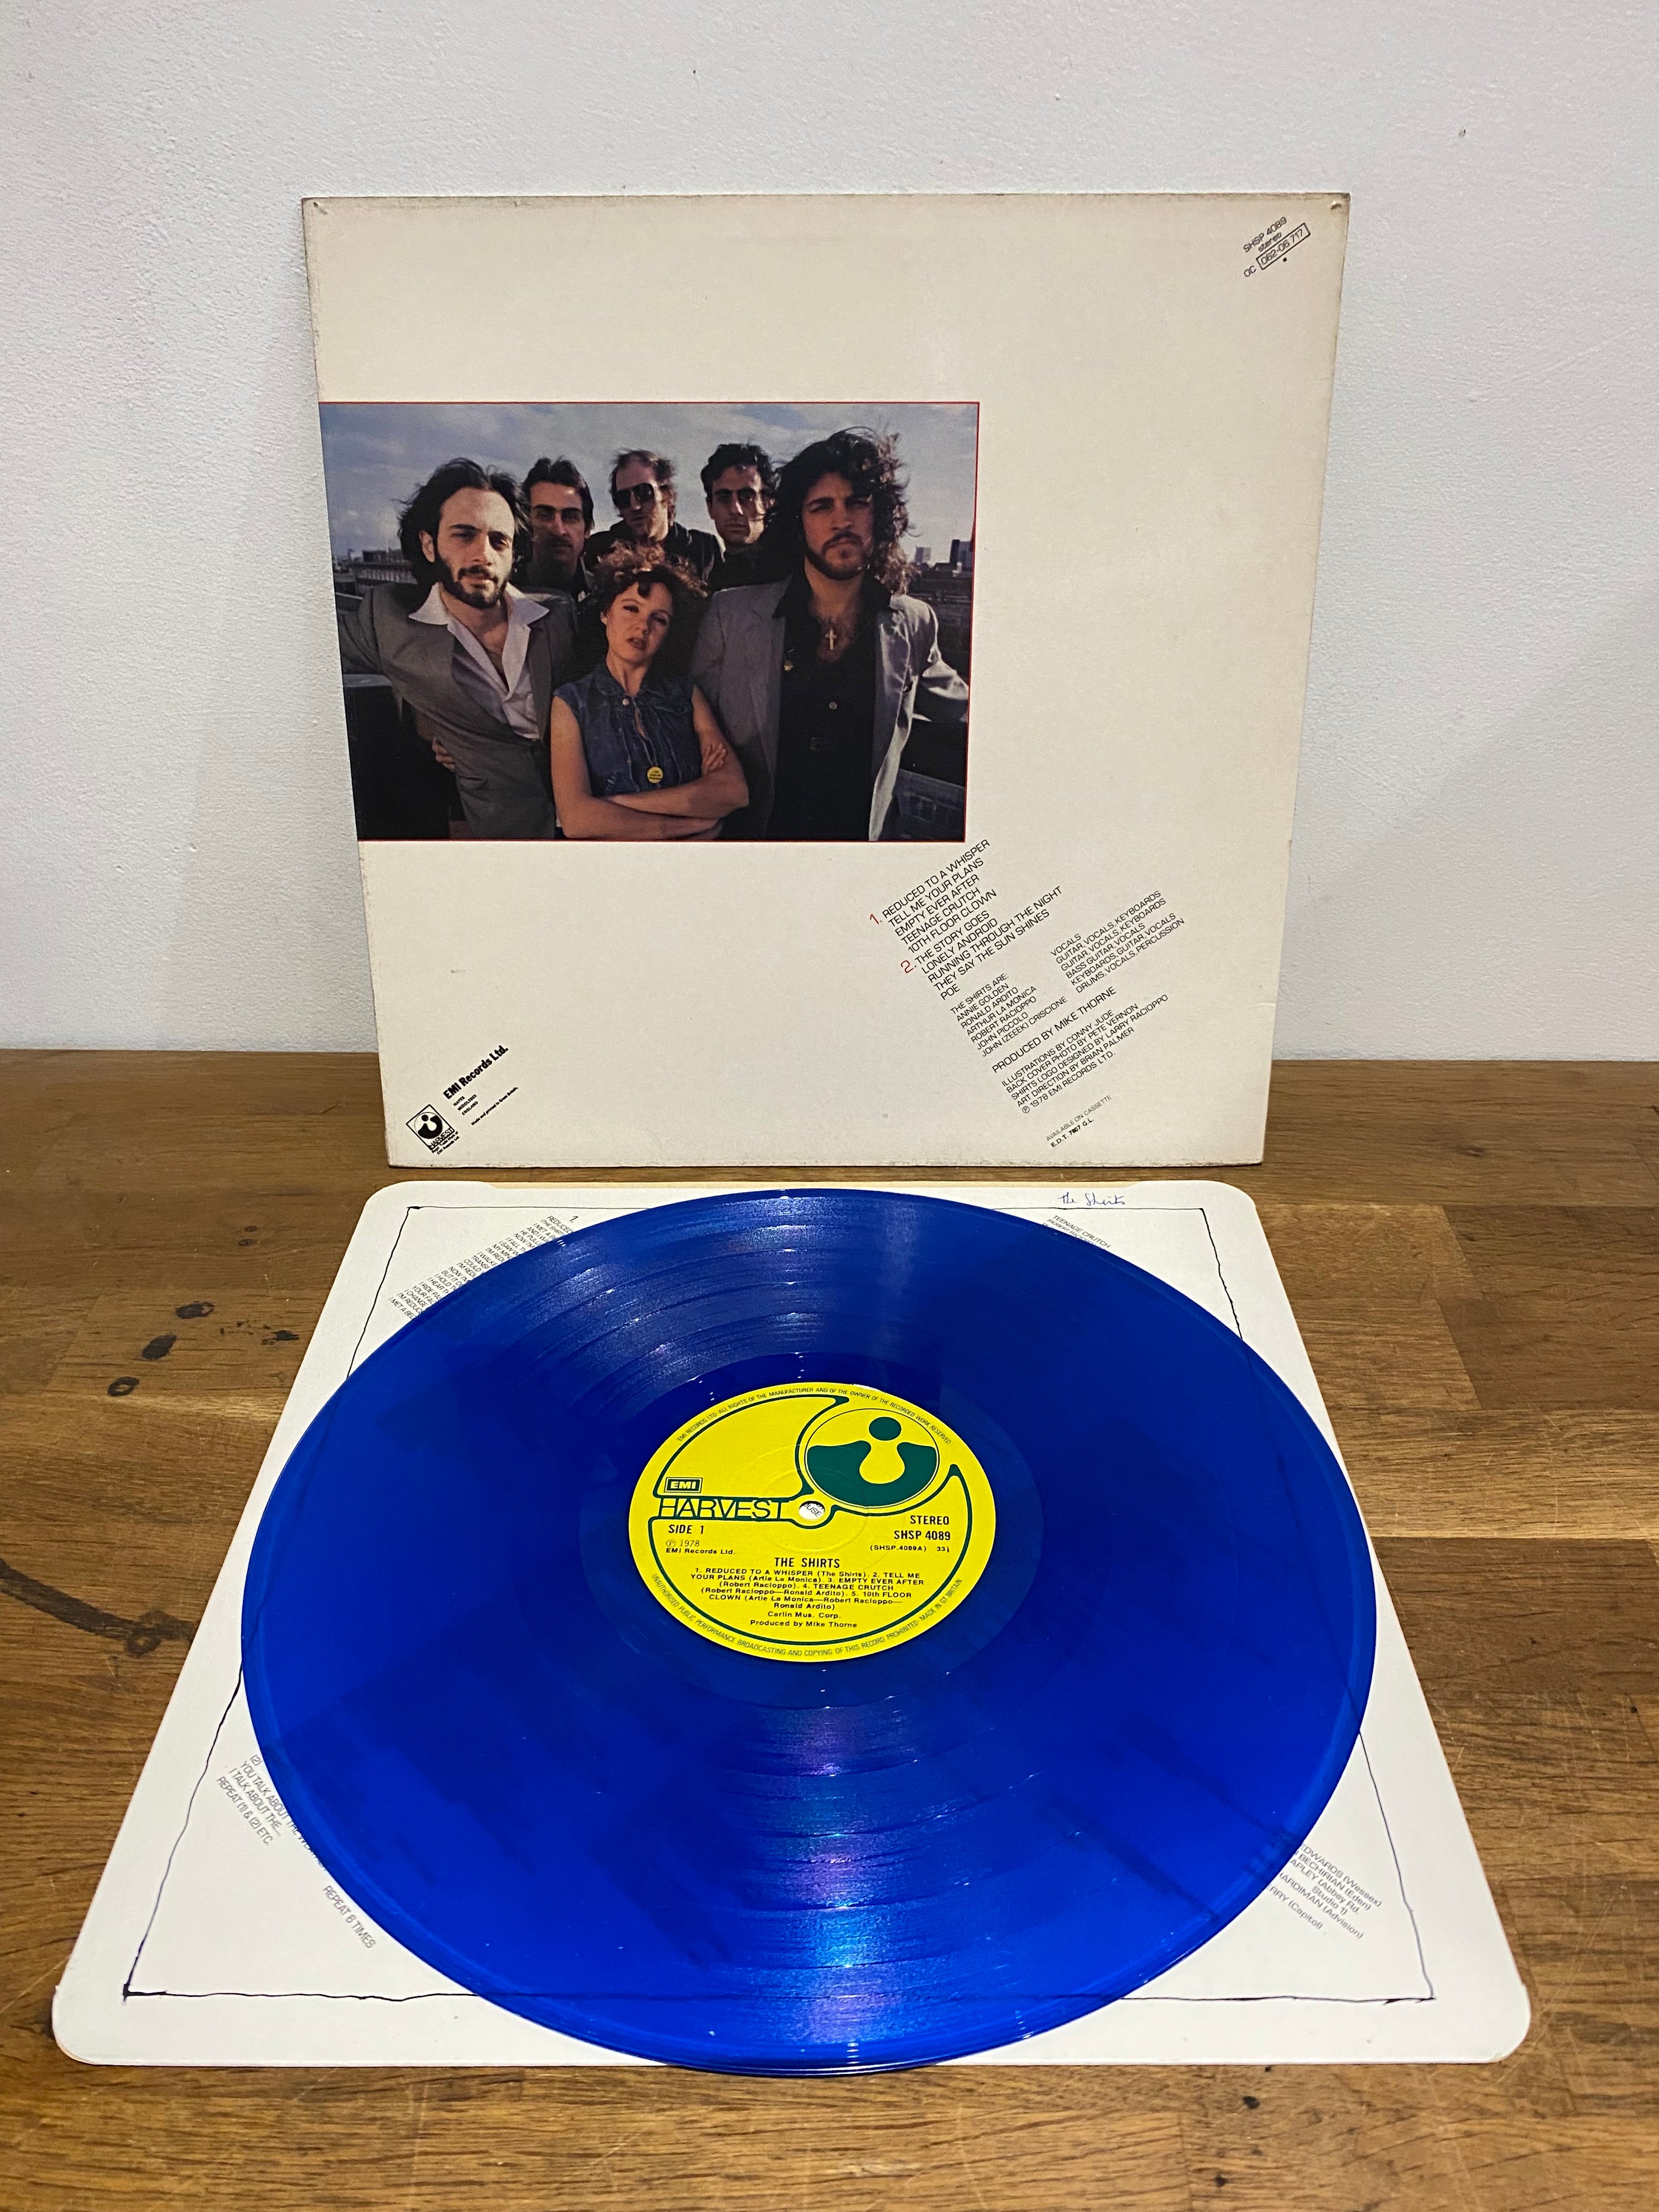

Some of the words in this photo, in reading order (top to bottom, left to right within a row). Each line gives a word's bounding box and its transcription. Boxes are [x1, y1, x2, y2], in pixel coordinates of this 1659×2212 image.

[1243, 232, 1265, 253] SHSP
[1266, 216, 1287, 235] 4089
[1243, 265, 1256, 277] OC
[1260, 239, 1290, 265] 062-06
[1289, 228, 1302, 243] 717
[1258, 232, 1282, 252] stereo
[869, 914, 882, 924] 1.
[882, 885, 925, 919] REDUCED
[924, 875, 939, 887] TO
[940, 870, 948, 879] A
[946, 839, 990, 872] WHISPER
[888, 910, 911, 927] TELL
[910, 898, 926, 912] ME
[925, 879, 953, 900] YOUR
[951, 857, 984, 883] PLANS
[895, 910, 925, 936] EMPTY
[926, 894, 951, 915] EVER
[951, 874, 979, 898] AFTER
[900, 912, 943, 945] TEENAGE
[942, 886, 980, 917] CRUTCH
[908, 935, 931, 953] 10TH
[930, 914, 961, 939] FLOOR
[960, 889, 997, 917] CLOWN
[927, 950, 971, 983] RUNNING
[969, 919, 1015, 953] THROUGH
[1014, 906, 1034, 922] THE
[1033, 885, 1061, 910] NIGHT
[900, 960, 916, 973] 2.
[914, 948, 935, 964] THE
[933, 927, 963, 952] STORY
[963, 910, 989, 931] GOES
[921, 946, 954, 974] LONELY
[957, 918, 998, 951] ANDROID
[933, 971, 957, 990] THEY
[957, 958, 975, 975] SAY
[975, 946, 995, 962] THE
[994, 932, 1015, 950] SUN
[1015, 909, 1049, 936] SHINES
[1050, 933, 1081, 956] VOCALS
[940, 983, 960, 1000] POE
[950, 1001, 966, 1014] THE
[965, 984, 992, 1004] SHIRTS
[957, 1003, 979, 1022] ANNIE
[978, 983, 1009, 1006] GOLDEN
[961, 1005, 991, 1029] RONALD
[992, 987, 1018, 1008] ARDITO
[967, 1013, 997, 1036] ARTHUR
[995, 1006, 1006, 1015] LA
[1005, 986, 1036, 1008] MONICA
[971, 1020, 999, 1043] ROBERT
[999, 995, 1036, 1024] RACIOPPO
[977, 1032, 997, 1050] JOHN
[997, 1012, 1028, 1036] PICCOLO
[982, 1040, 1002, 1057] JOHN
[1001, 1022, 1029, 1043] (ZEEEK)
[1028, 996, 1067, 1025] CRISCIONE
[992, 1037, 1041, 1073] PRODUCED
[1041, 1027, 1053, 1040] BY
[1054, 1011, 1078, 1031] MIKE
[1077, 986, 1116, 1015] THORNE
[1001, 1048, 1056, 1087] ILLUSTRATIONS
[1055, 1041, 1066, 1051] BY
[1066, 1023, 1092, 1044] CONNY
[1095, 1009, 1114, 1026] JUDE
[1006, 1077, 1027, 1093] BACK
[1026, 1060, 1052, 1079] COVER
[1051, 1044, 1077, 1063] PHOTO
[1076, 1036, 1087, 1046] BY
[1087, 1024, 1107, 1039] PETE
[1105, 1003, 1138, 1026] VERNON
[1011, 1080, 1037, 1100] SHIRTS
[1037, 1066, 1058, 1083] LOGO
[1057, 1042, 1094, 1070] DESIGNED
[1094, 1035, 1104, 1046] BY
[1105, 1019, 1129, 1038] LARRY
[1130, 994, 1168, 1022] RACIOPPO
[1017, 1093, 1031, 1107] ART
[1031, 1069, 1069, 1097] DIRECTION
[1069, 1062, 1079, 1072] BY
[1079, 1046, 1103, 1065] BRIAN
[1103, 1026, 1134, 1050] PALMER
[442, 1082, 462, 1099] EMI
[458, 1058, 492, 1087] Records
[489, 1045, 509, 1061] Ltd.
[1030, 1093, 1048, 1107] 1978
[1048, 1084, 1062, 1096] EMI
[1062, 1061, 1097, 1087] RECORDS
[427, 1126, 454, 1149] HARVEST
[1053, 1215, 1083, 1233] TEENAGE
[1082, 1231, 1111, 1248] CRUTCH
[659, 1496, 789, 1521] HARVEST
[670, 1481, 697, 1489] EMI
[668, 1525, 693, 1534] SIDE
[700, 1525, 705, 1535] 1
[894, 1530, 922, 1540] SHSP
[925, 1530, 951, 1541] 4089
[910, 1515, 950, 1525] STEREO
[774, 1557, 794, 1567] THE
[801, 1557, 839, 1568] SHIRTS
[216, 1776, 243, 1803] REPEAT
[232, 1770, 251, 1791] TALK
[244, 1790, 271, 1814] ABOUT
[322, 1885, 351, 1916] REPEAT
[346, 1914, 356, 1923] 6
[352, 1920, 375, 1948] TIMES
